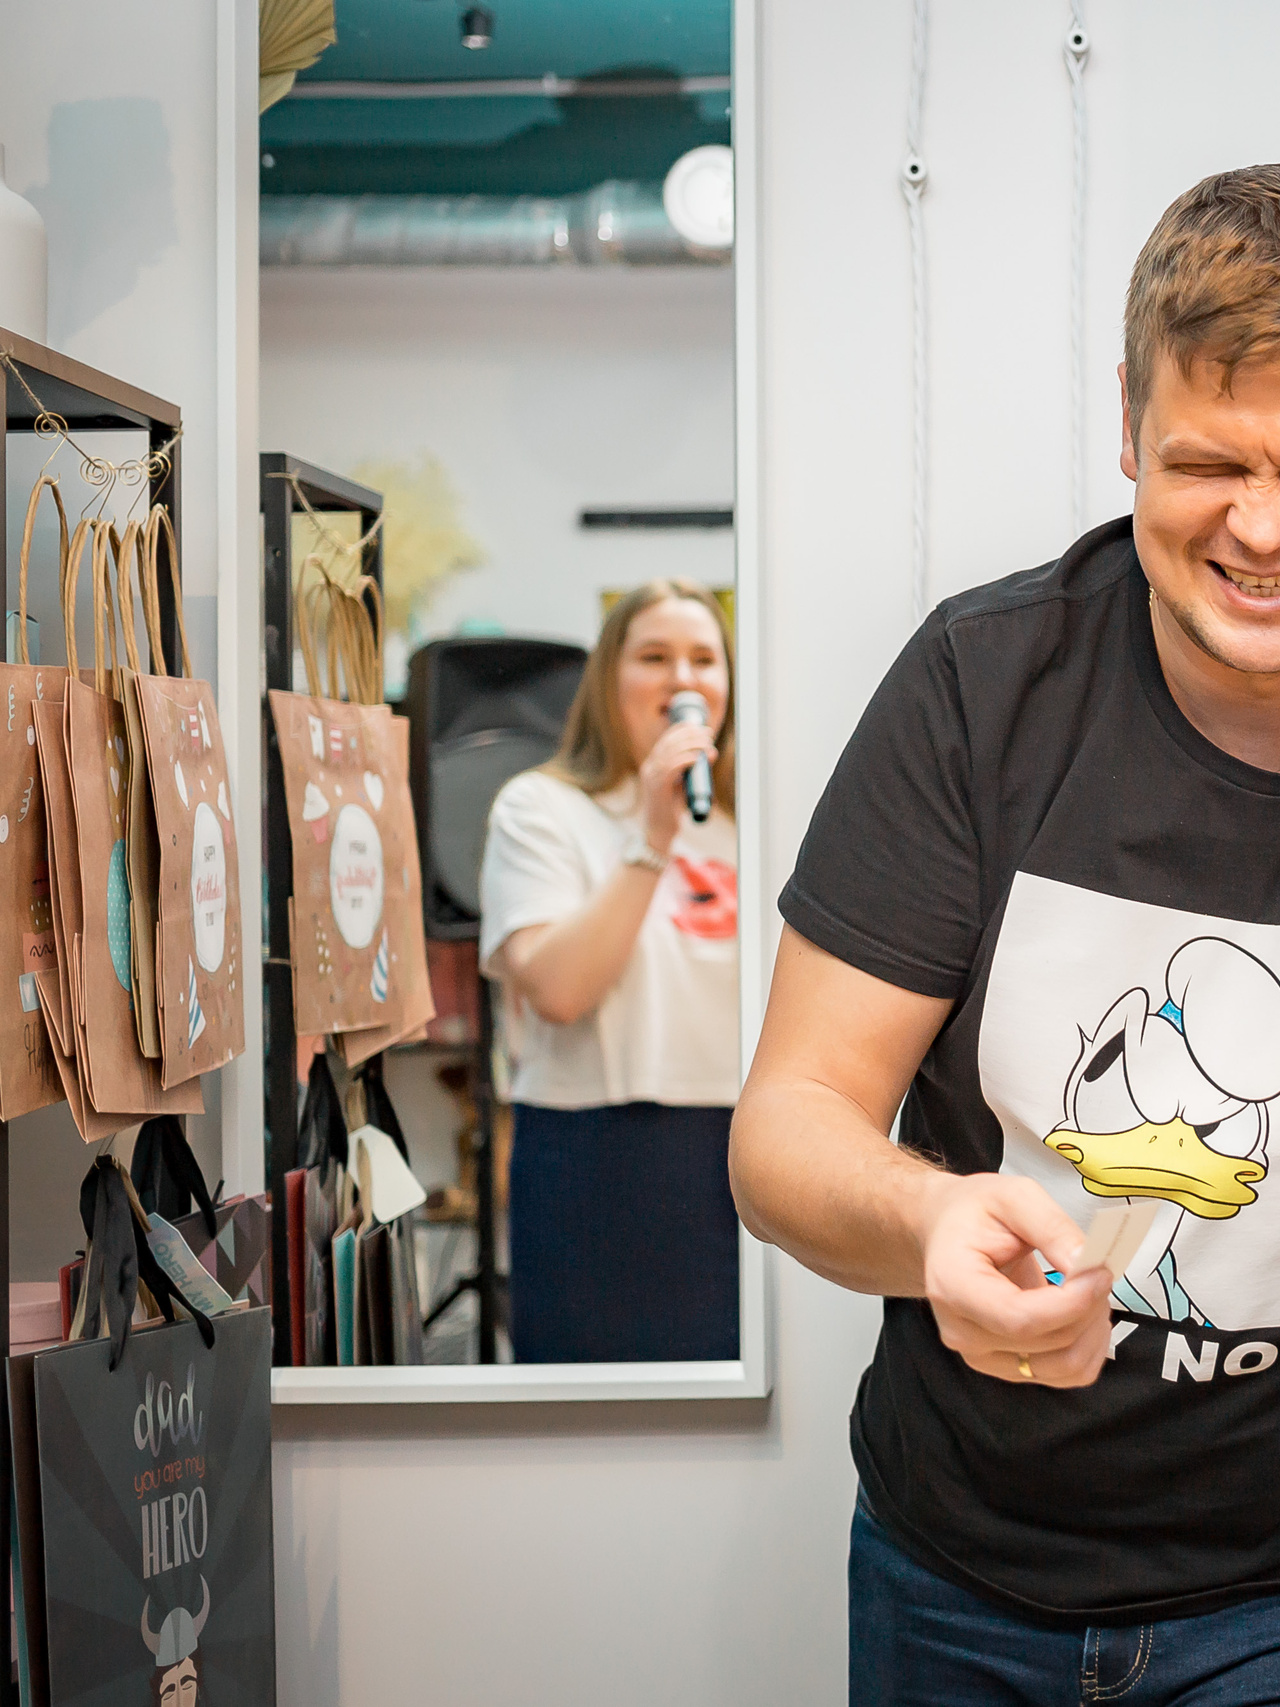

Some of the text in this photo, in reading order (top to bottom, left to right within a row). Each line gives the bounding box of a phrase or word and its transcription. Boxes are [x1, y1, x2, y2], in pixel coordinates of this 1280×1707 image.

[154, 1243, 193, 1291] HERO
[133, 1363, 203, 1458] dad
[134, 1456, 206, 1500] you are my
[141, 1486, 209, 1580] HERO
